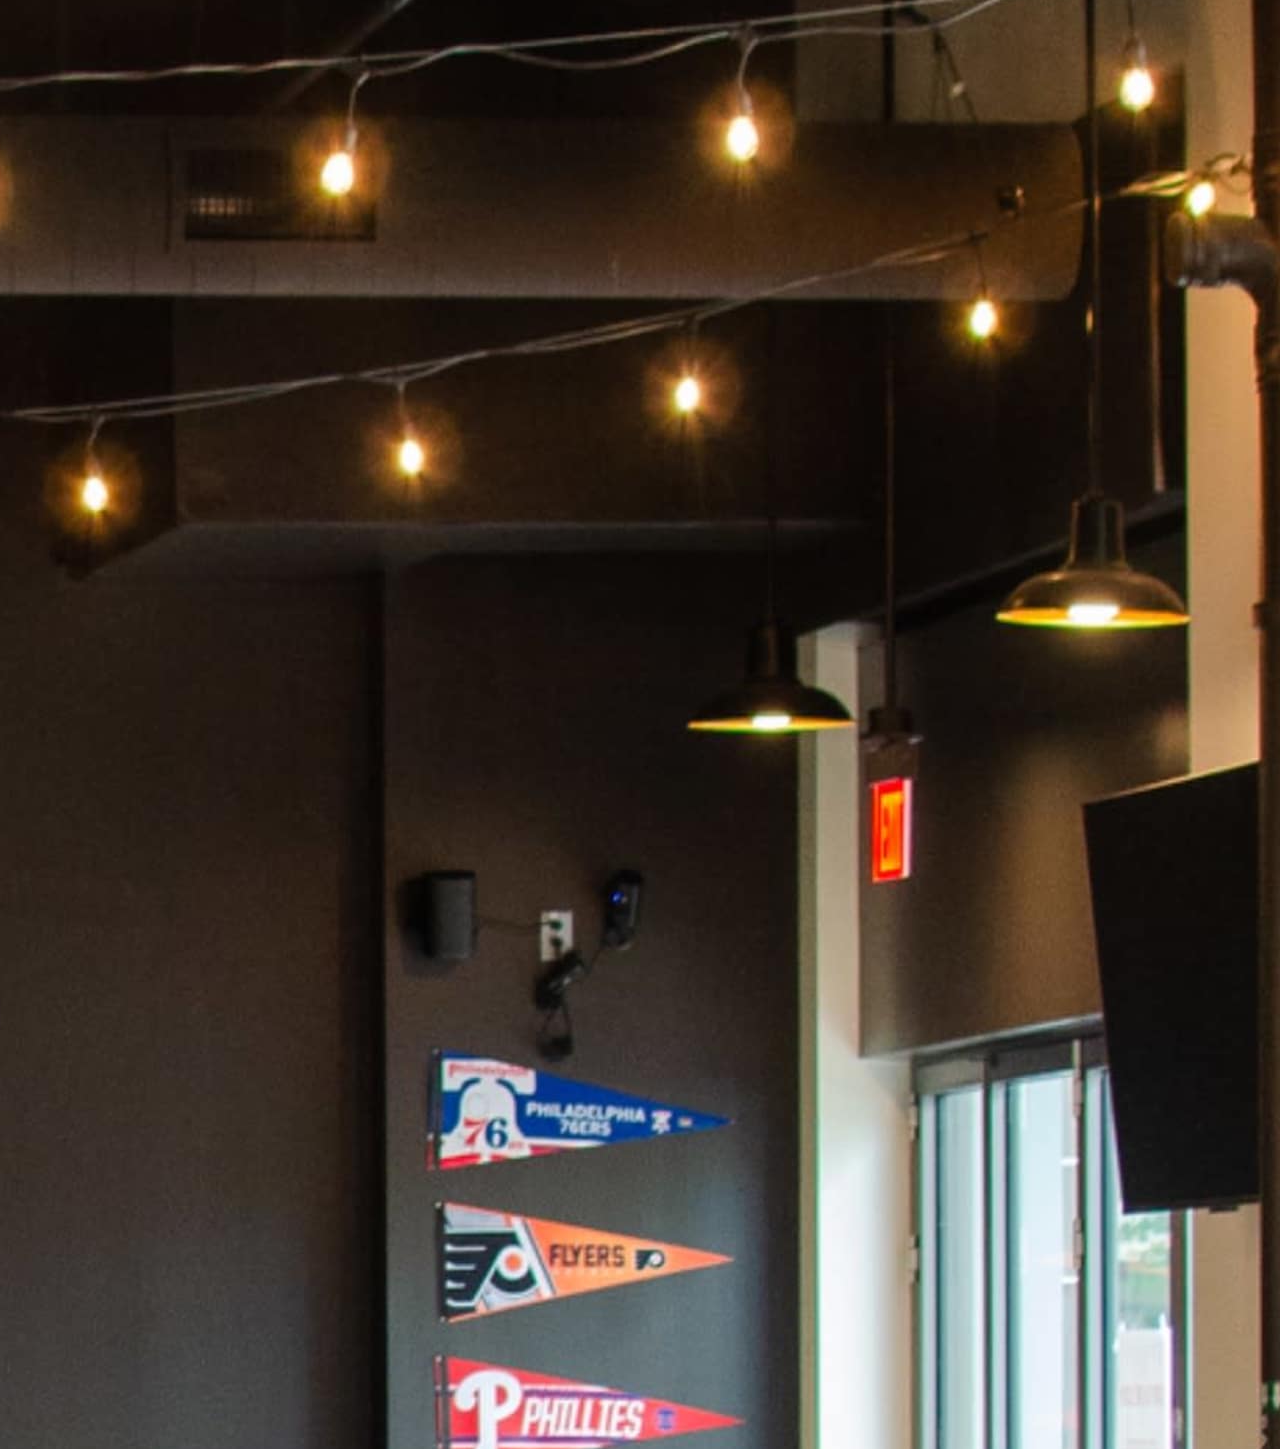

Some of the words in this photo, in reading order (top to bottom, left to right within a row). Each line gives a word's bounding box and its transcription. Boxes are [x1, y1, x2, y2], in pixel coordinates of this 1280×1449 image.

[526, 1101, 646, 1123] PHILADELPHIA
[463, 1116, 508, 1149] 76
[560, 1117, 612, 1136] 76ERS
[549, 1243, 625, 1268] FLYERS
[521, 1397, 645, 1438] PHILLIES
